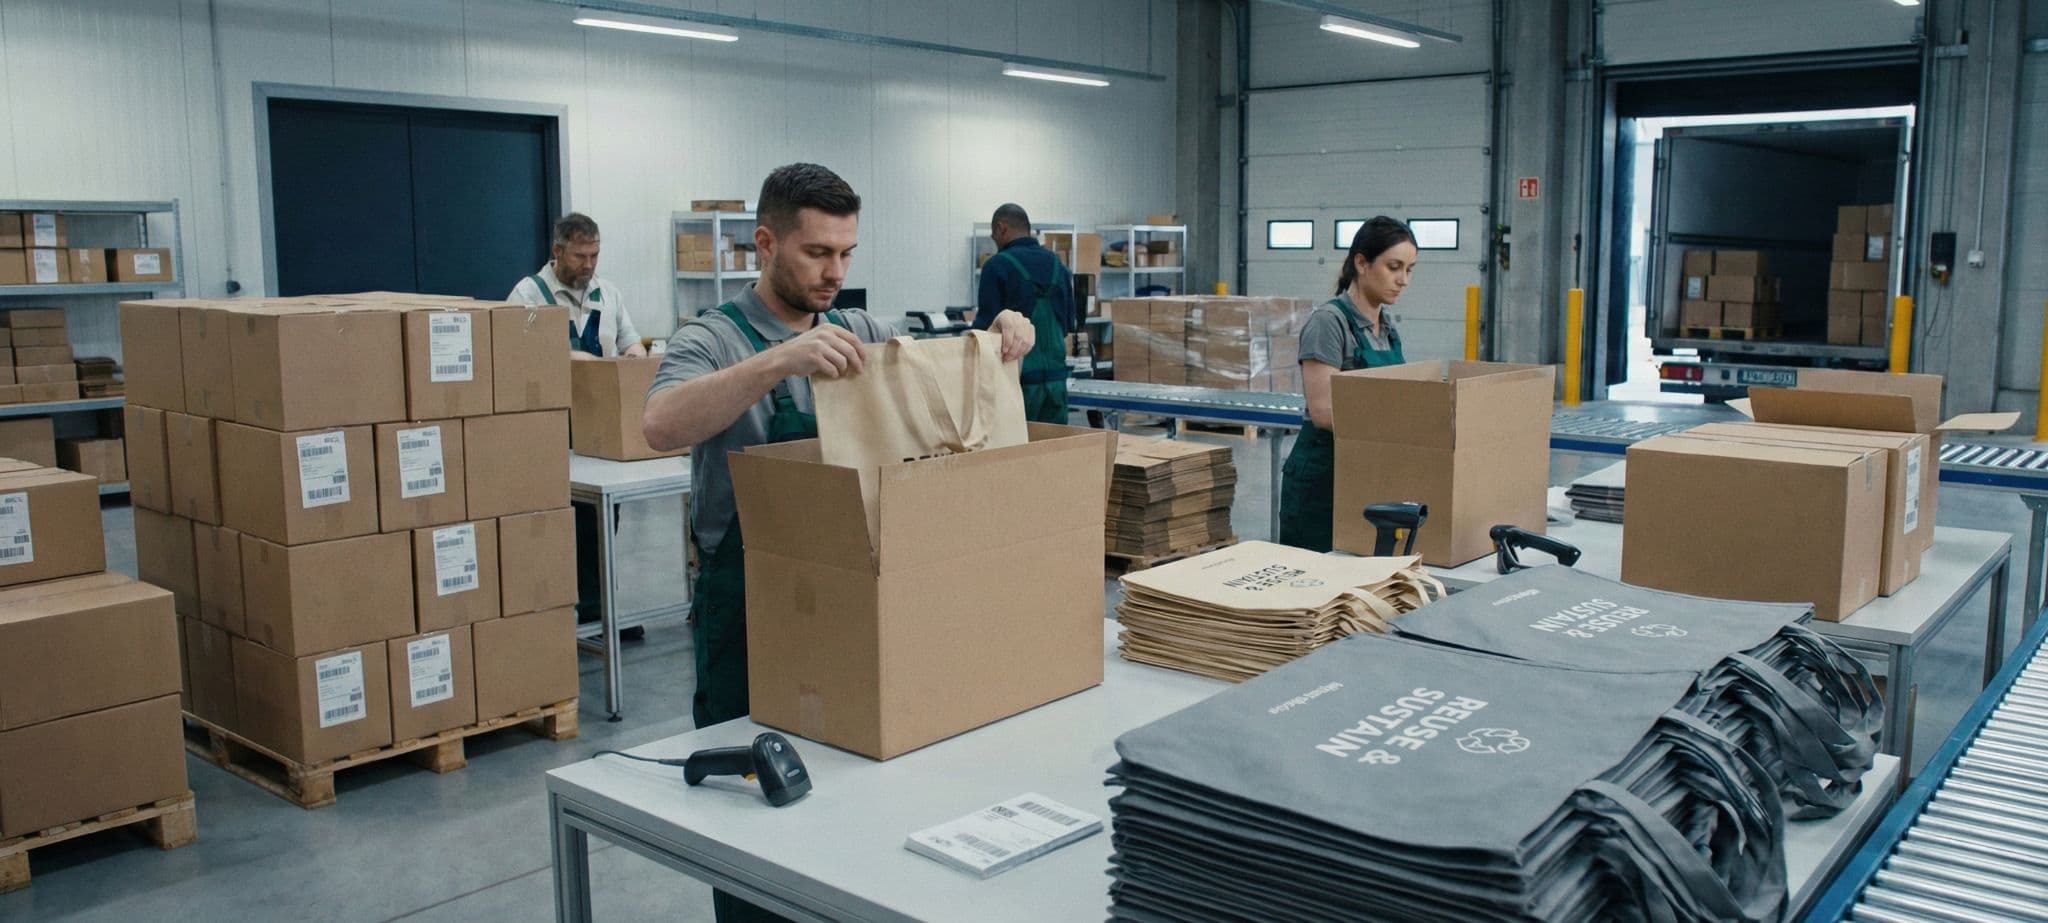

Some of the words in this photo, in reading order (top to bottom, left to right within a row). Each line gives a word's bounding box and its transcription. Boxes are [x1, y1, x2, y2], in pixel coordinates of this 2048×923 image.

[1223, 564, 1287, 588] SUSTAIN
[1256, 569, 1306, 587] REUSE
[1528, 598, 1618, 632] SUSTAIN
[1578, 605, 1651, 633] REUSE
[1564, 628, 1594, 638] &
[1315, 687, 1446, 758] SUSTAIN
[1384, 696, 1488, 751] REUSE
[1358, 749, 1401, 765] &
